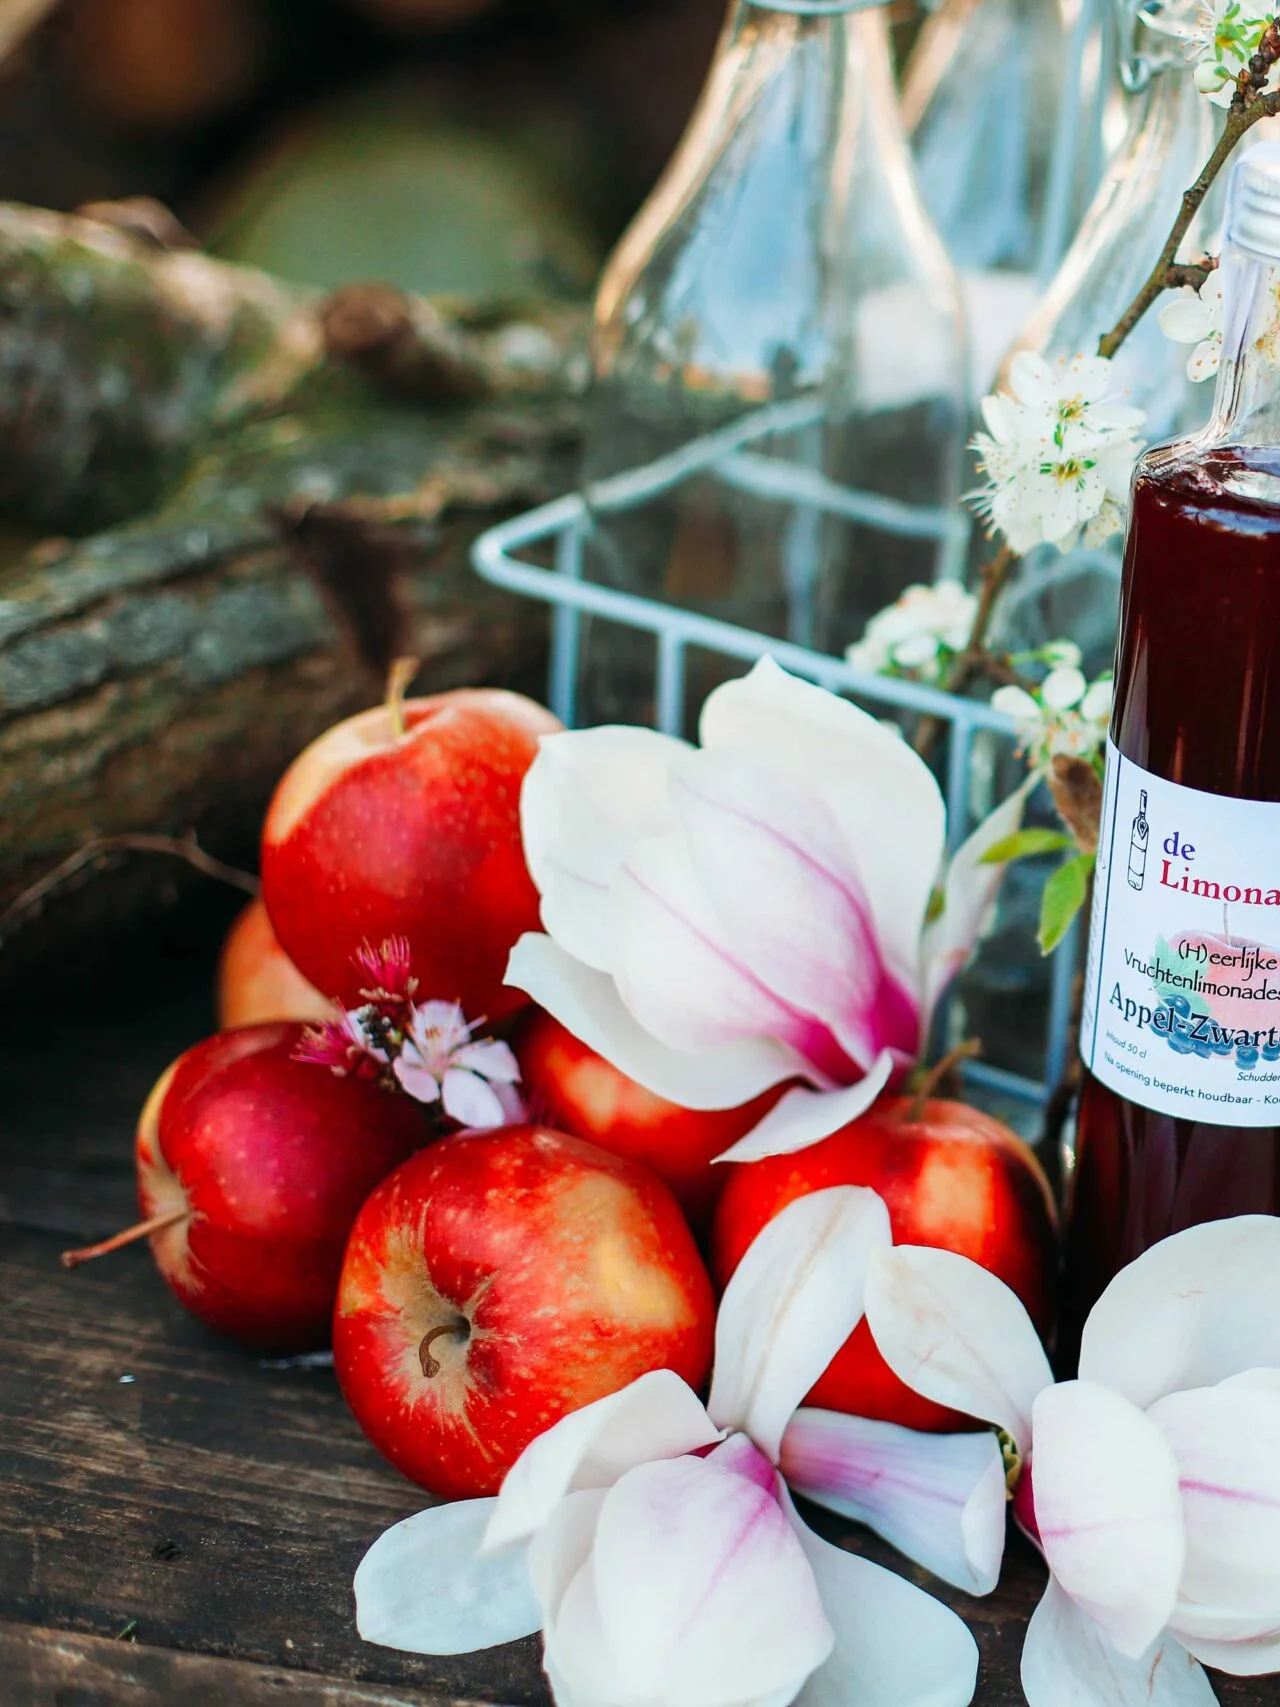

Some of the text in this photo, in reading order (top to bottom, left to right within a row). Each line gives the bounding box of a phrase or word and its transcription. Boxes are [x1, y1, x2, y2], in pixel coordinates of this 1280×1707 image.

[1163, 831, 1196, 861] de
[1178, 939, 1278, 982] (H)eerlijke
[1128, 1043, 1138, 1055] 50
[1139, 1050, 1147, 1059] cl
[1104, 1050, 1114, 1065] Na
[1116, 1062, 1151, 1087] opening
[1153, 1076, 1195, 1098] beperkt
[1198, 1088, 1253, 1105] houdbaar
